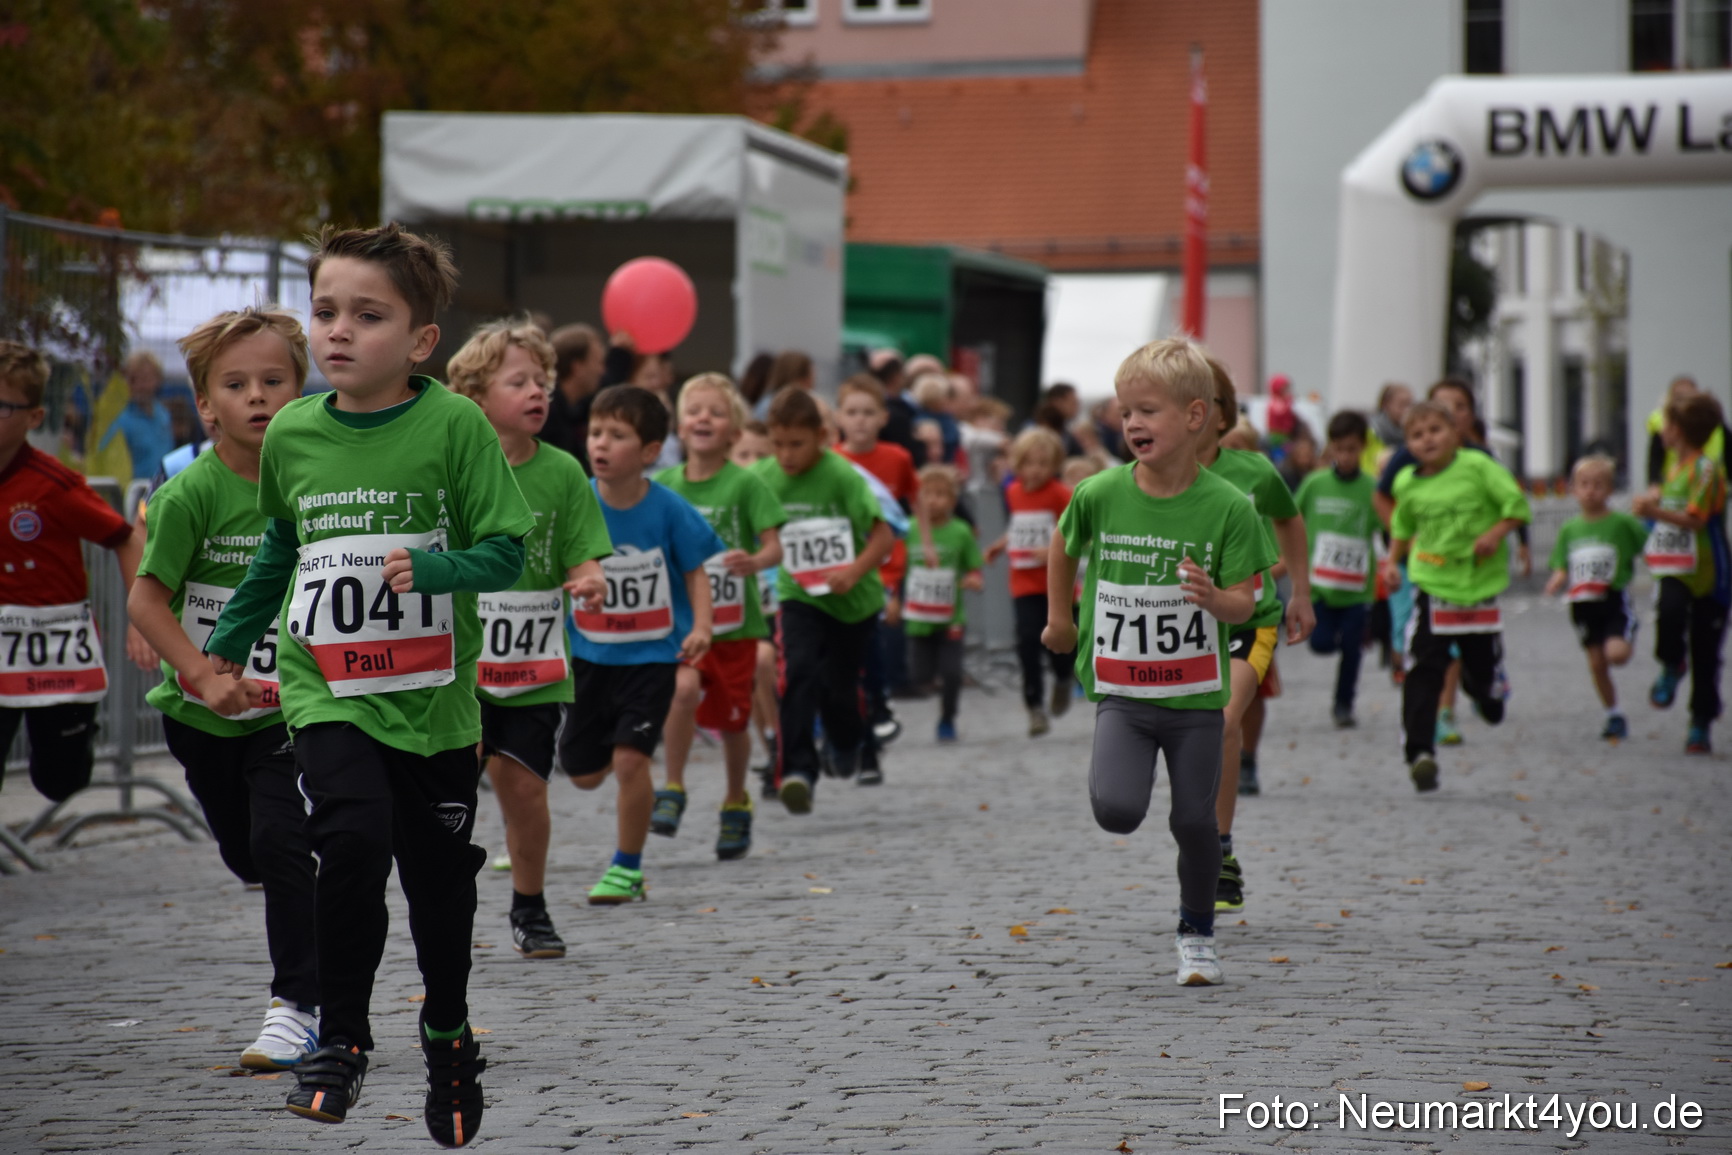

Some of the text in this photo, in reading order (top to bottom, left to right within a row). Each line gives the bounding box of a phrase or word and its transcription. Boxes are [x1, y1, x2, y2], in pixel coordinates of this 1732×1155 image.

[1488, 104, 1657, 155] BMW
[298, 487, 398, 512] Neumarkter
[1100, 531, 1178, 550] Neumarkter
[786, 535, 847, 568] 7425
[1100, 549, 1159, 568] Stadtlauf
[298, 555, 337, 577] PARTL
[303, 576, 433, 637] 7041
[499, 602, 550, 613] Neumarkt
[1098, 593, 1132, 608] PARTL
[606, 617, 637, 630] Paul
[1106, 610, 1207, 655] 7154
[1, 628, 93, 667] 7073
[344, 647, 394, 673] Paul
[482, 666, 537, 683] Hannes
[1127, 665, 1183, 682] Tobias
[26, 676, 76, 692] Simon
